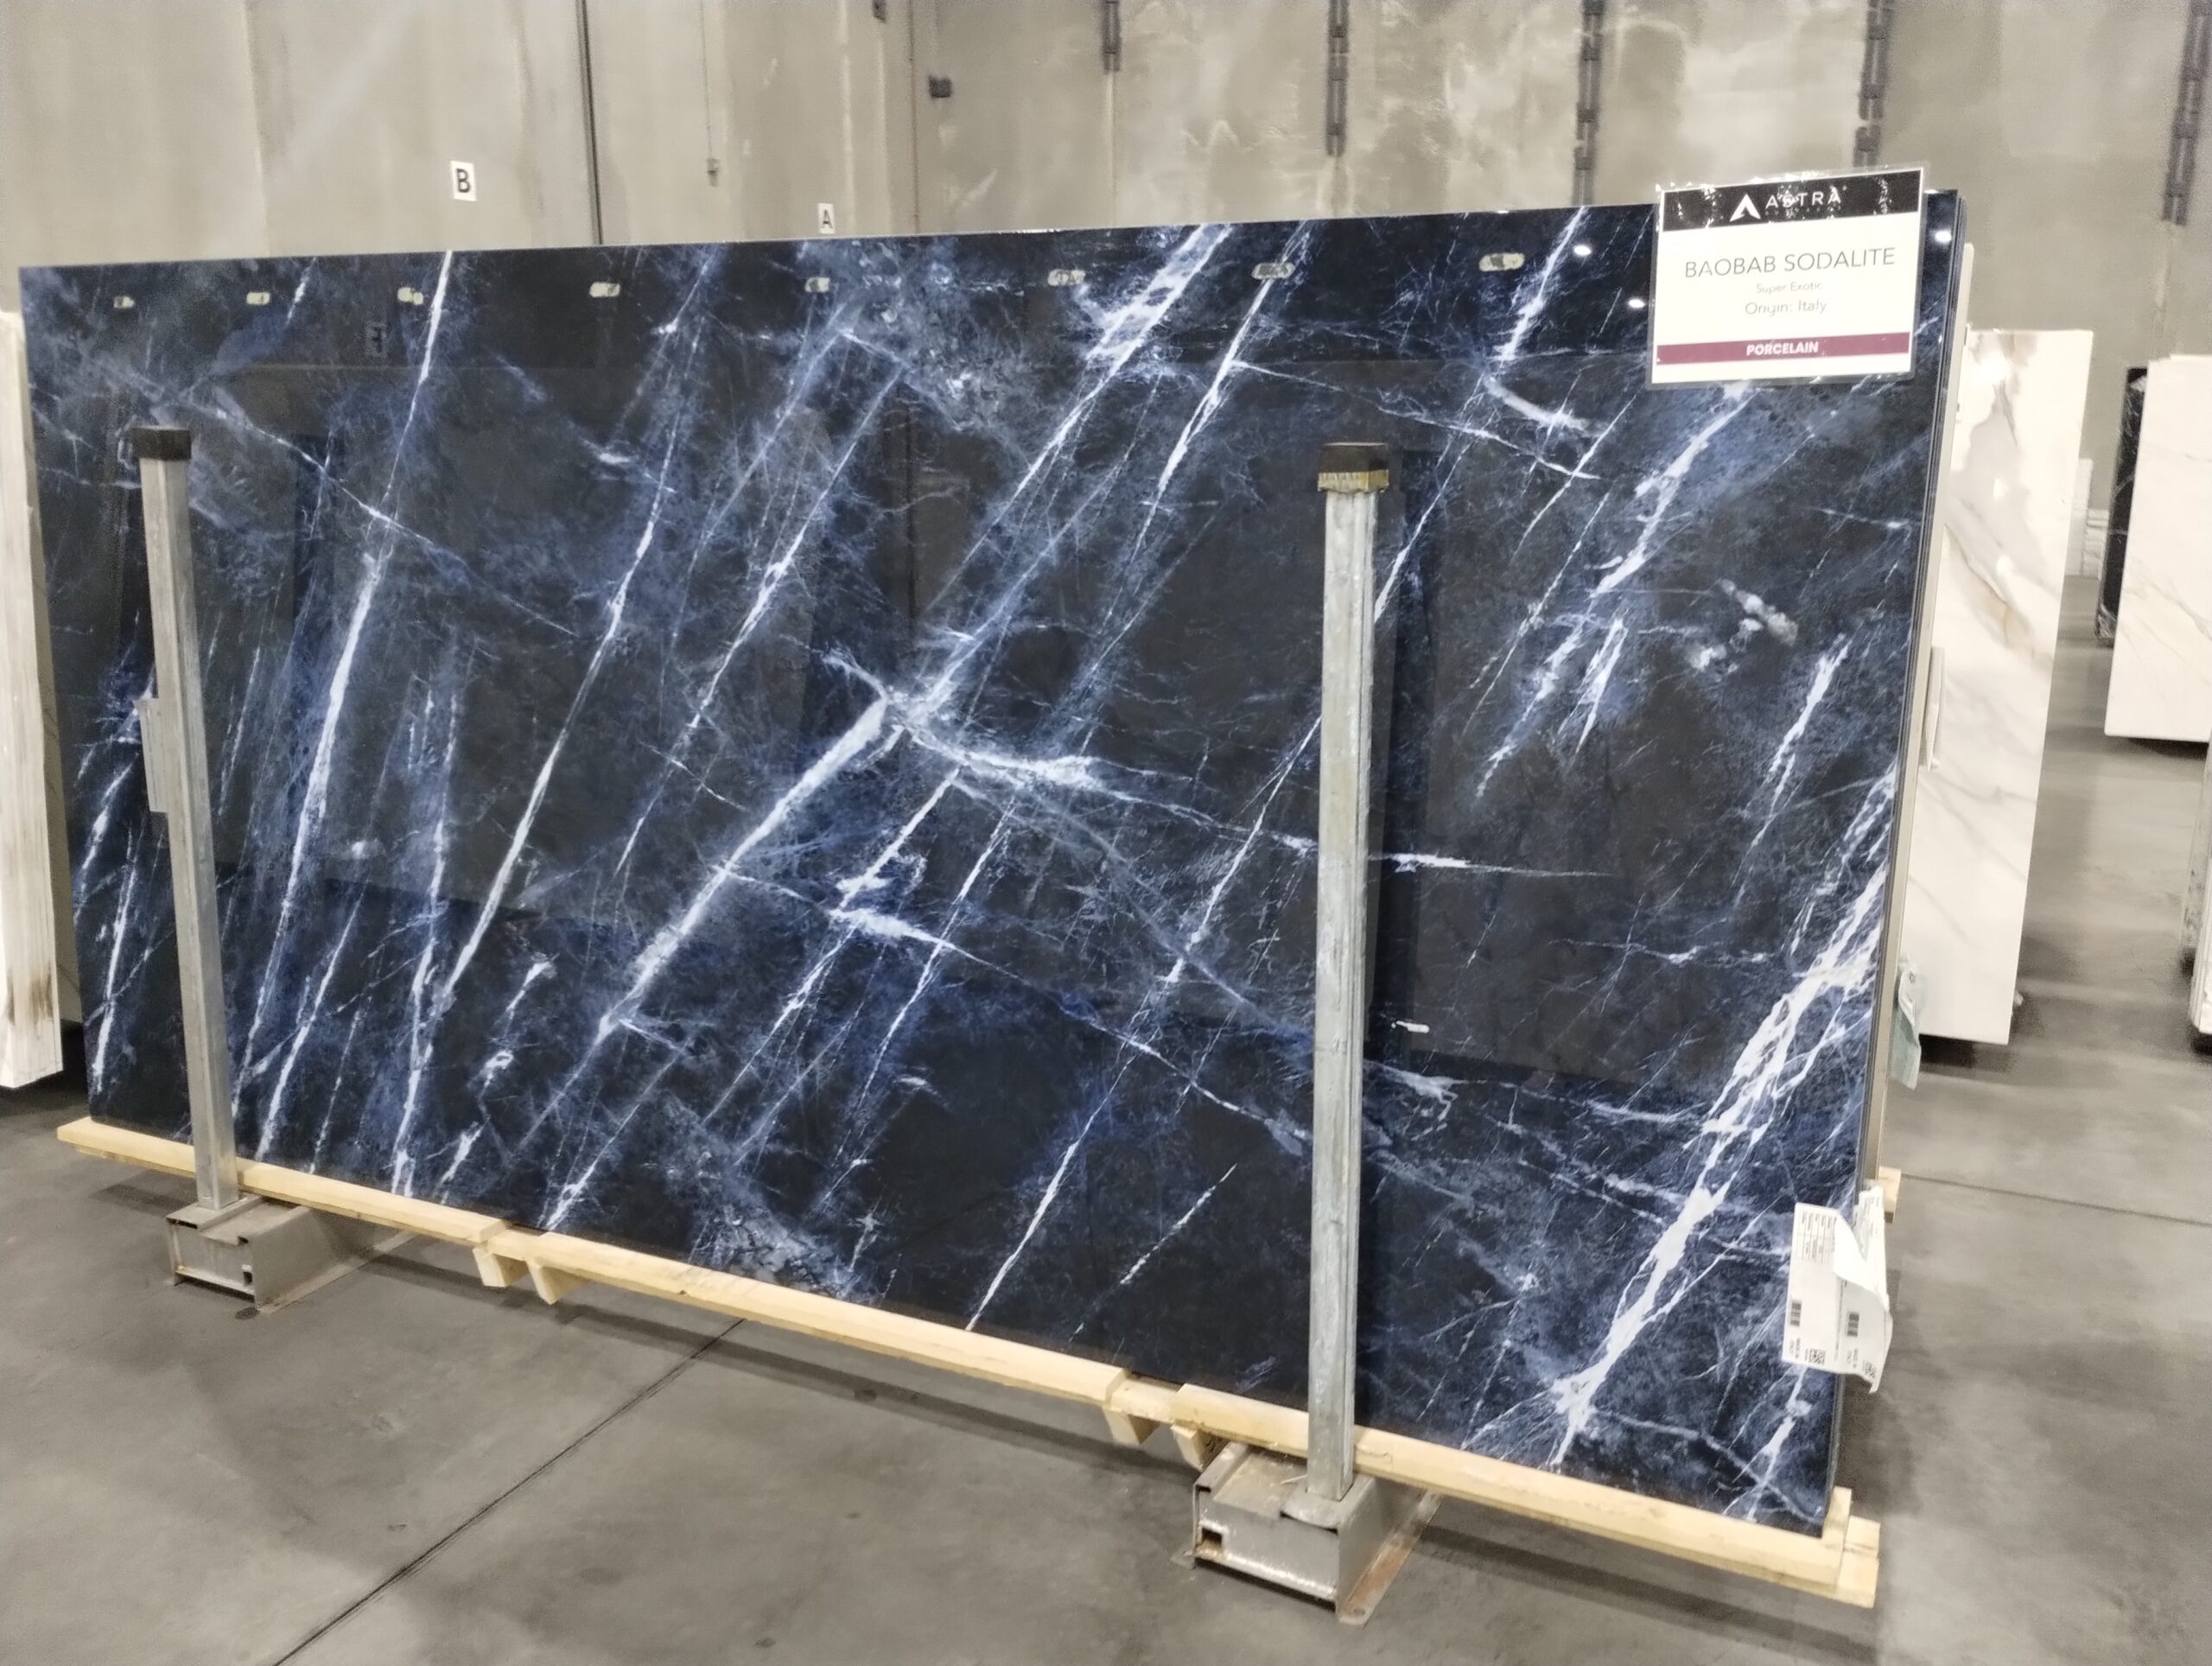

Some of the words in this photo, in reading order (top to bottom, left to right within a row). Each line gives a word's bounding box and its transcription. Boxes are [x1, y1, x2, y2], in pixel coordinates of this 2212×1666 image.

[456, 168, 470, 193] B
[822, 209, 833, 229] A
[1685, 256, 1776, 277] BAOBAB
[1783, 247, 1896, 271] SODALITE
[1756, 283, 1786, 295] Super
[1790, 281, 1822, 291] Exotic
[1745, 301, 1793, 317] Origin:
[1798, 298, 1827, 315] Italy
[1745, 340, 1819, 356] PORCELAIN
